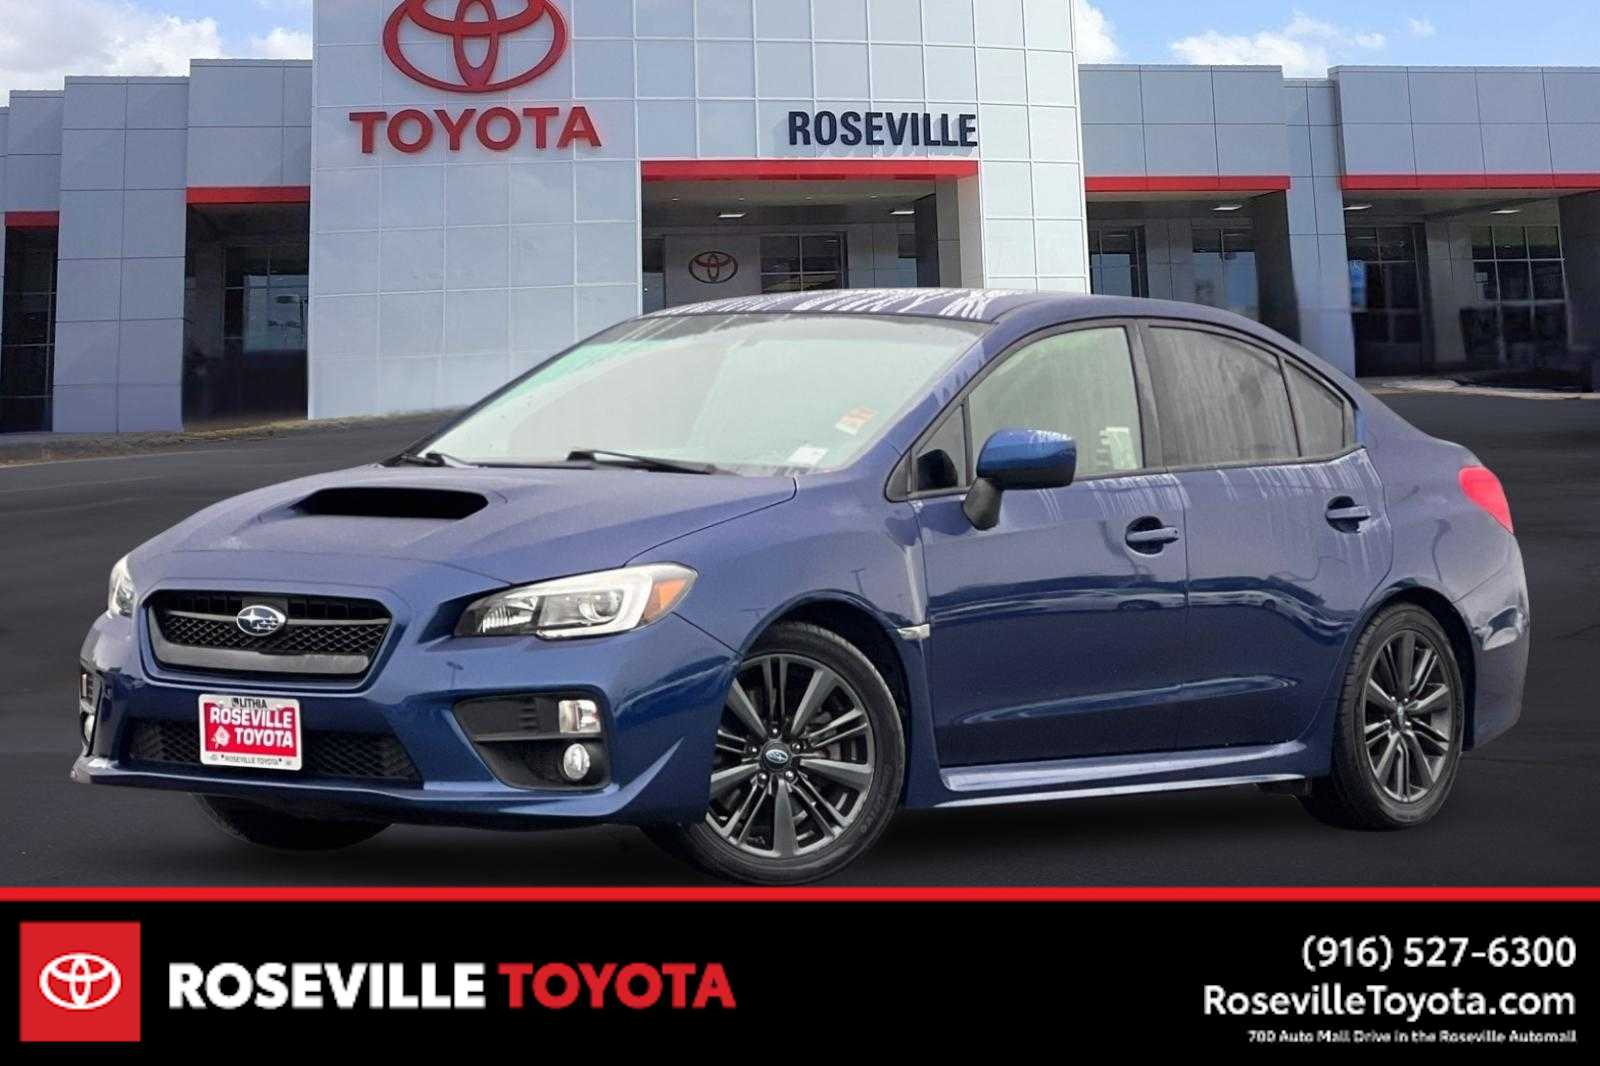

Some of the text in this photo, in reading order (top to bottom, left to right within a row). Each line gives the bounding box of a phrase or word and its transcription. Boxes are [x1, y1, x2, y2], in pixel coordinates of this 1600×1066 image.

[349, 106, 602, 153] TOYOTA
[788, 111, 978, 147] ROSEVILLE
[240, 698, 268, 708] LITHIA
[210, 706, 293, 728] ROSEVILLE
[234, 727, 293, 748] TOYOTA
[225, 755, 279, 765] ROSEVILLE TOYOTA
